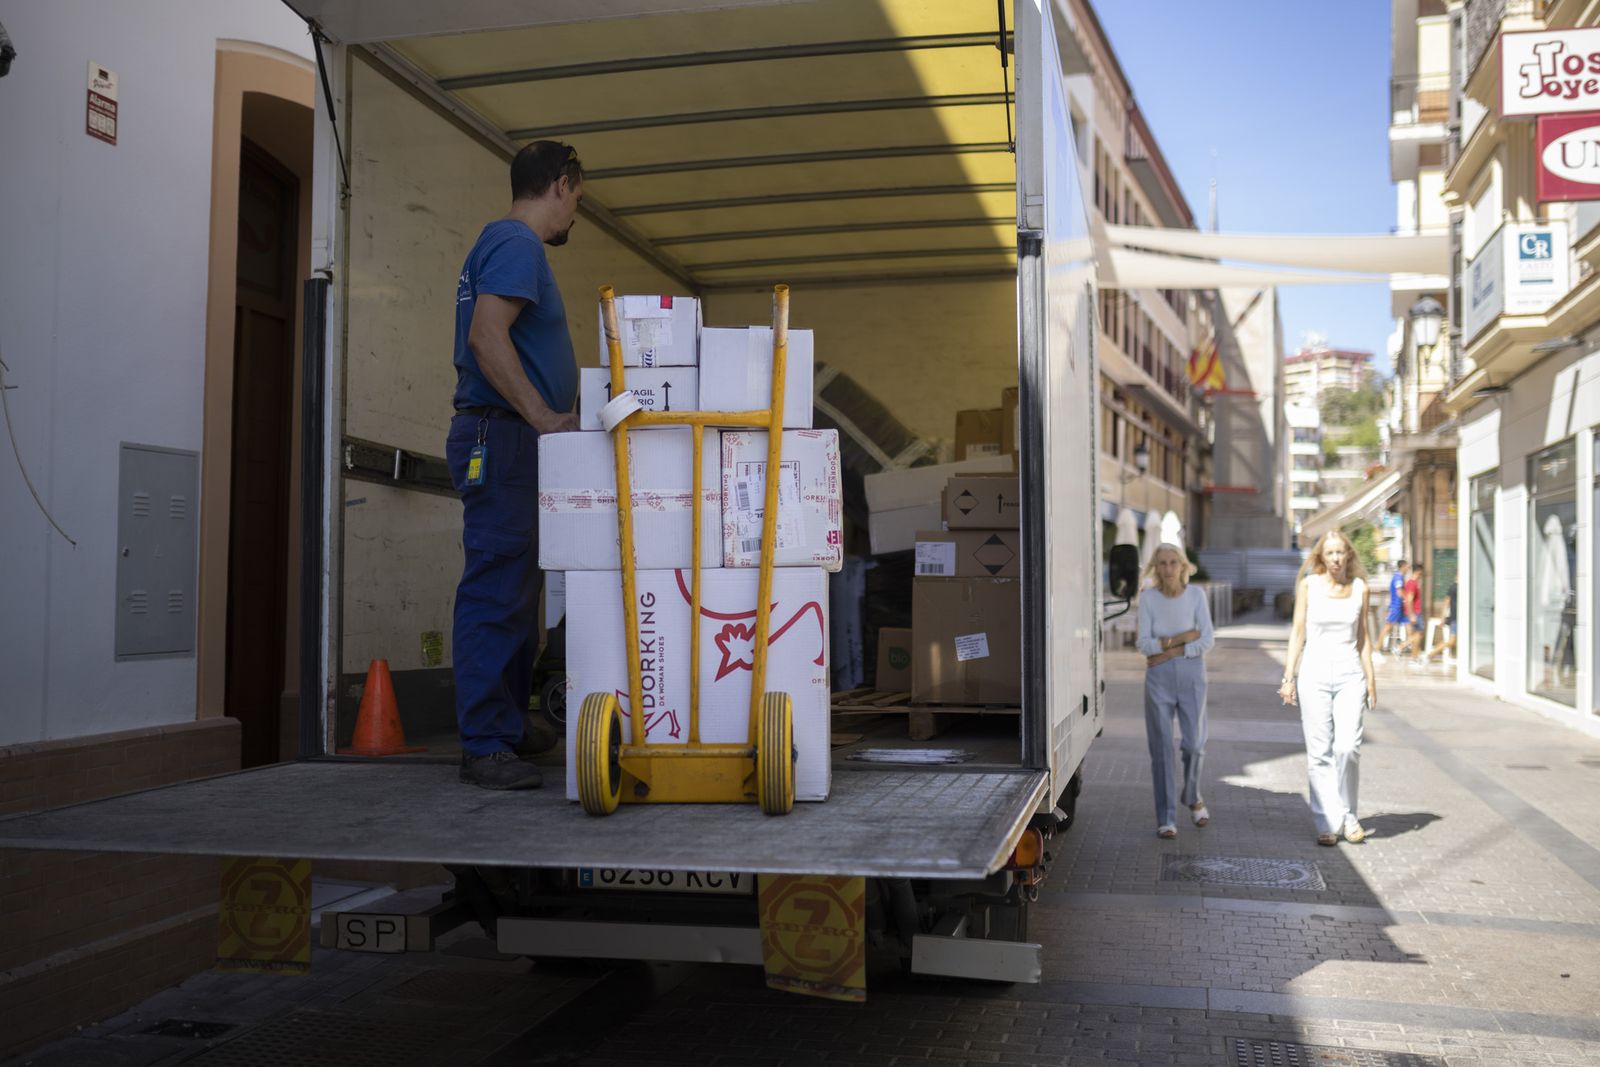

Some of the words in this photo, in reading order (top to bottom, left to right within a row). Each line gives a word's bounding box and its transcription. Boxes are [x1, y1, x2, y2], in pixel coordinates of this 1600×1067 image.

[89, 92, 116, 114] Alarma
[1521, 234, 1550, 259] CR
[640, 591, 656, 708] DORKING
[658, 696, 665, 707] DK
[583, 873, 590, 881] E
[346, 919, 397, 949] SP
[765, 920, 860, 938] ZEPRO
